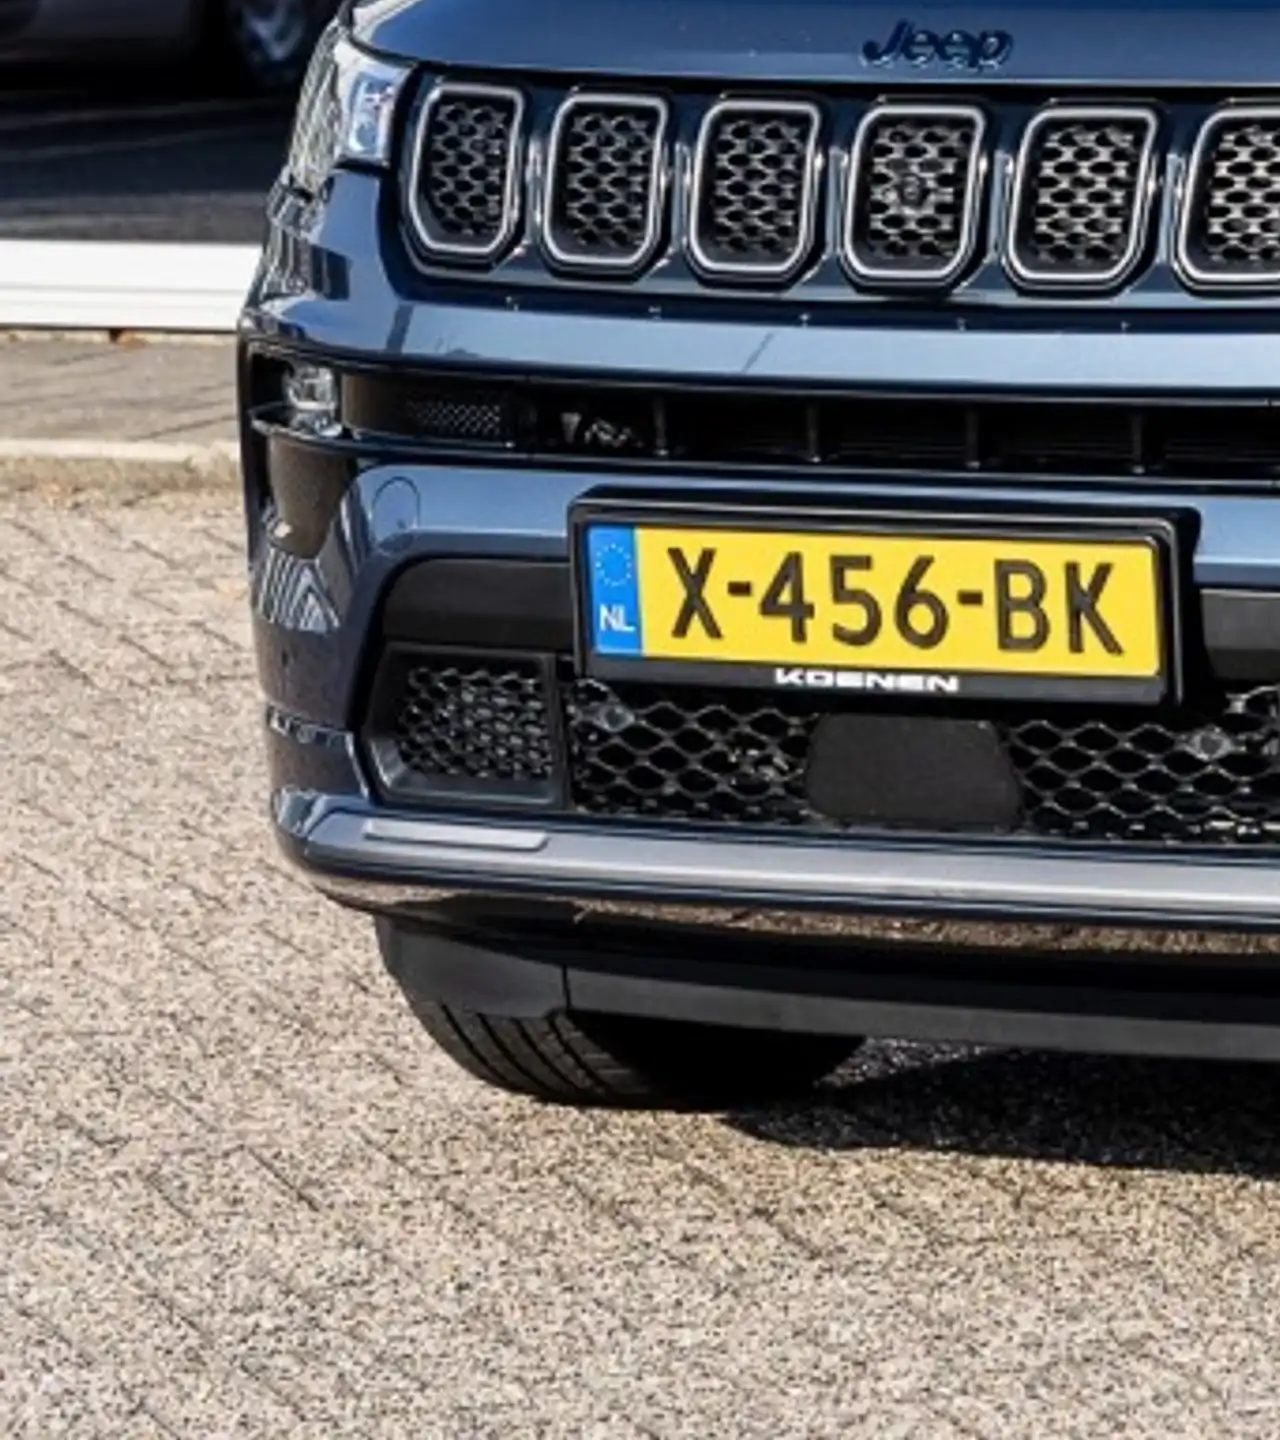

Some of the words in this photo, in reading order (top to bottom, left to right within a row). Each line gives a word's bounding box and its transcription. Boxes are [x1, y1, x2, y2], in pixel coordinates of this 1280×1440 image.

[862, 17, 1013, 71] Jeep
[600, 603, 636, 632] NL
[667, 546, 1125, 656] X-456-BK
[774, 667, 960, 692] KOENEN
